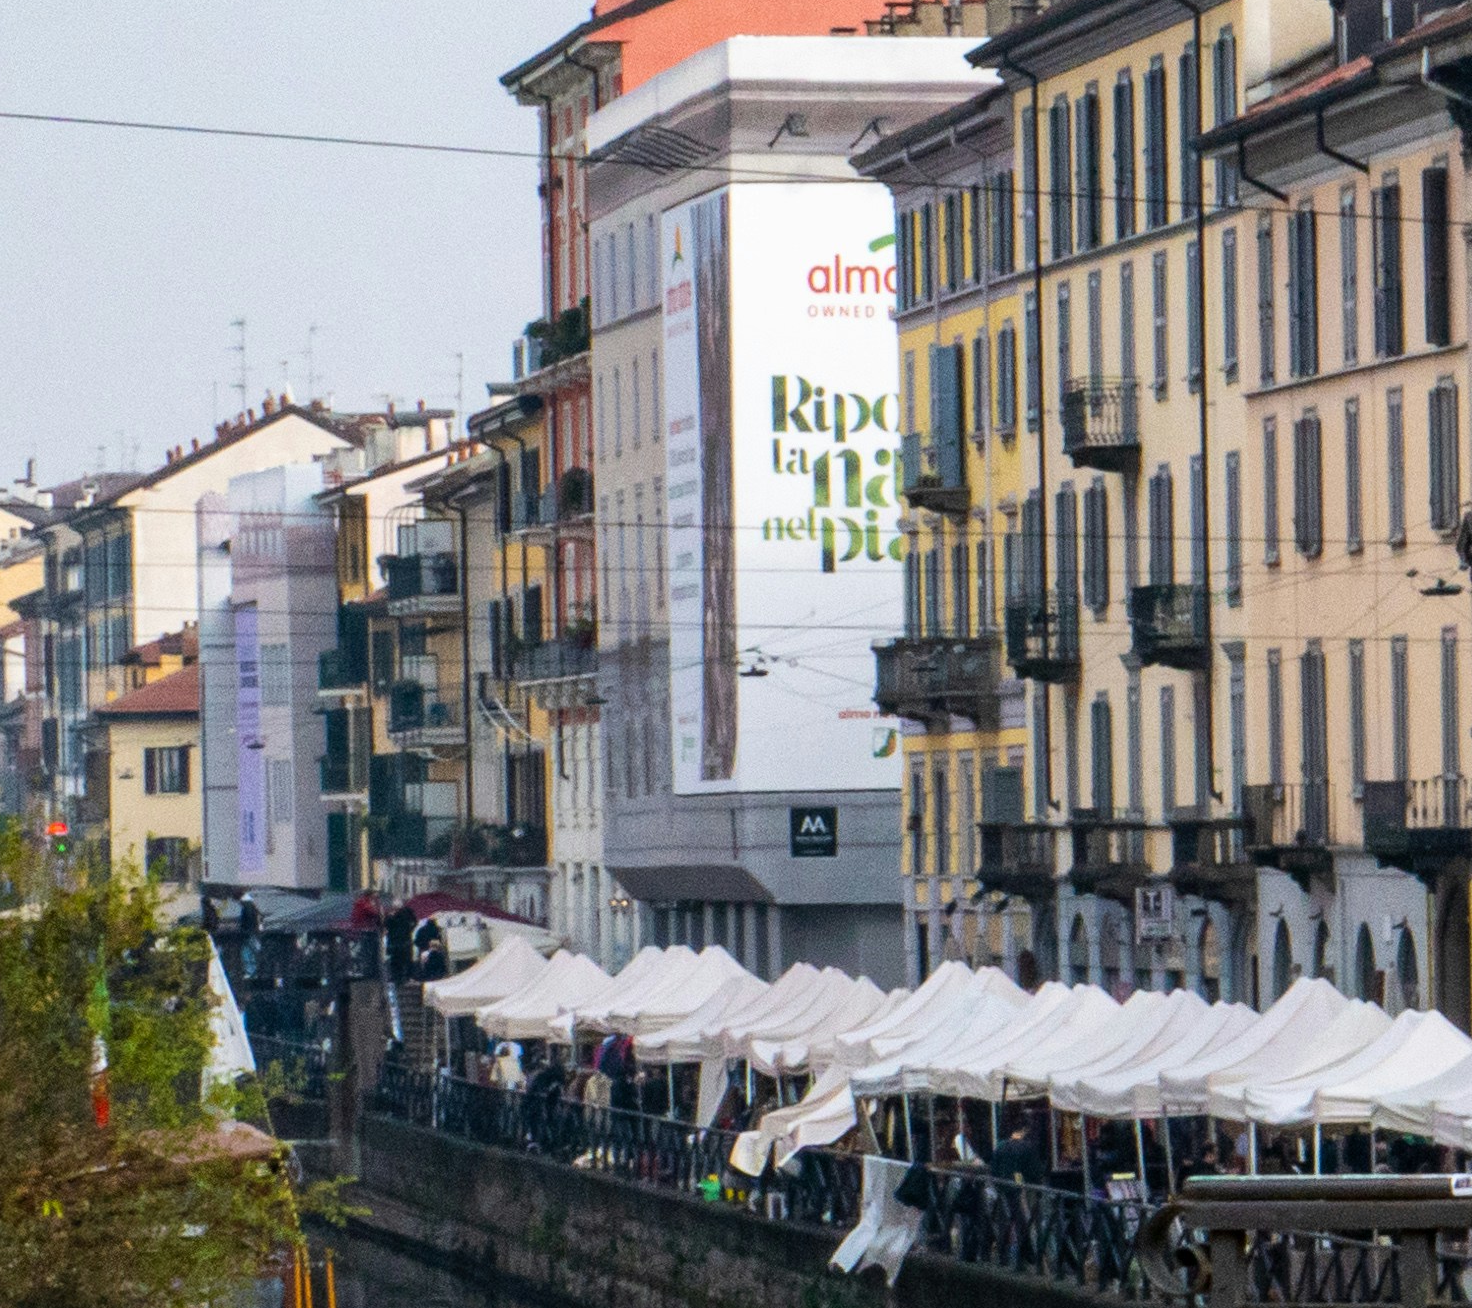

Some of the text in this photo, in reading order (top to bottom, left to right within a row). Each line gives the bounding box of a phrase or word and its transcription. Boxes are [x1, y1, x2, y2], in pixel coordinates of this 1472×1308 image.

[808, 305, 875, 318] OWNED
[773, 438, 810, 475] la
[763, 506, 817, 541] nel
